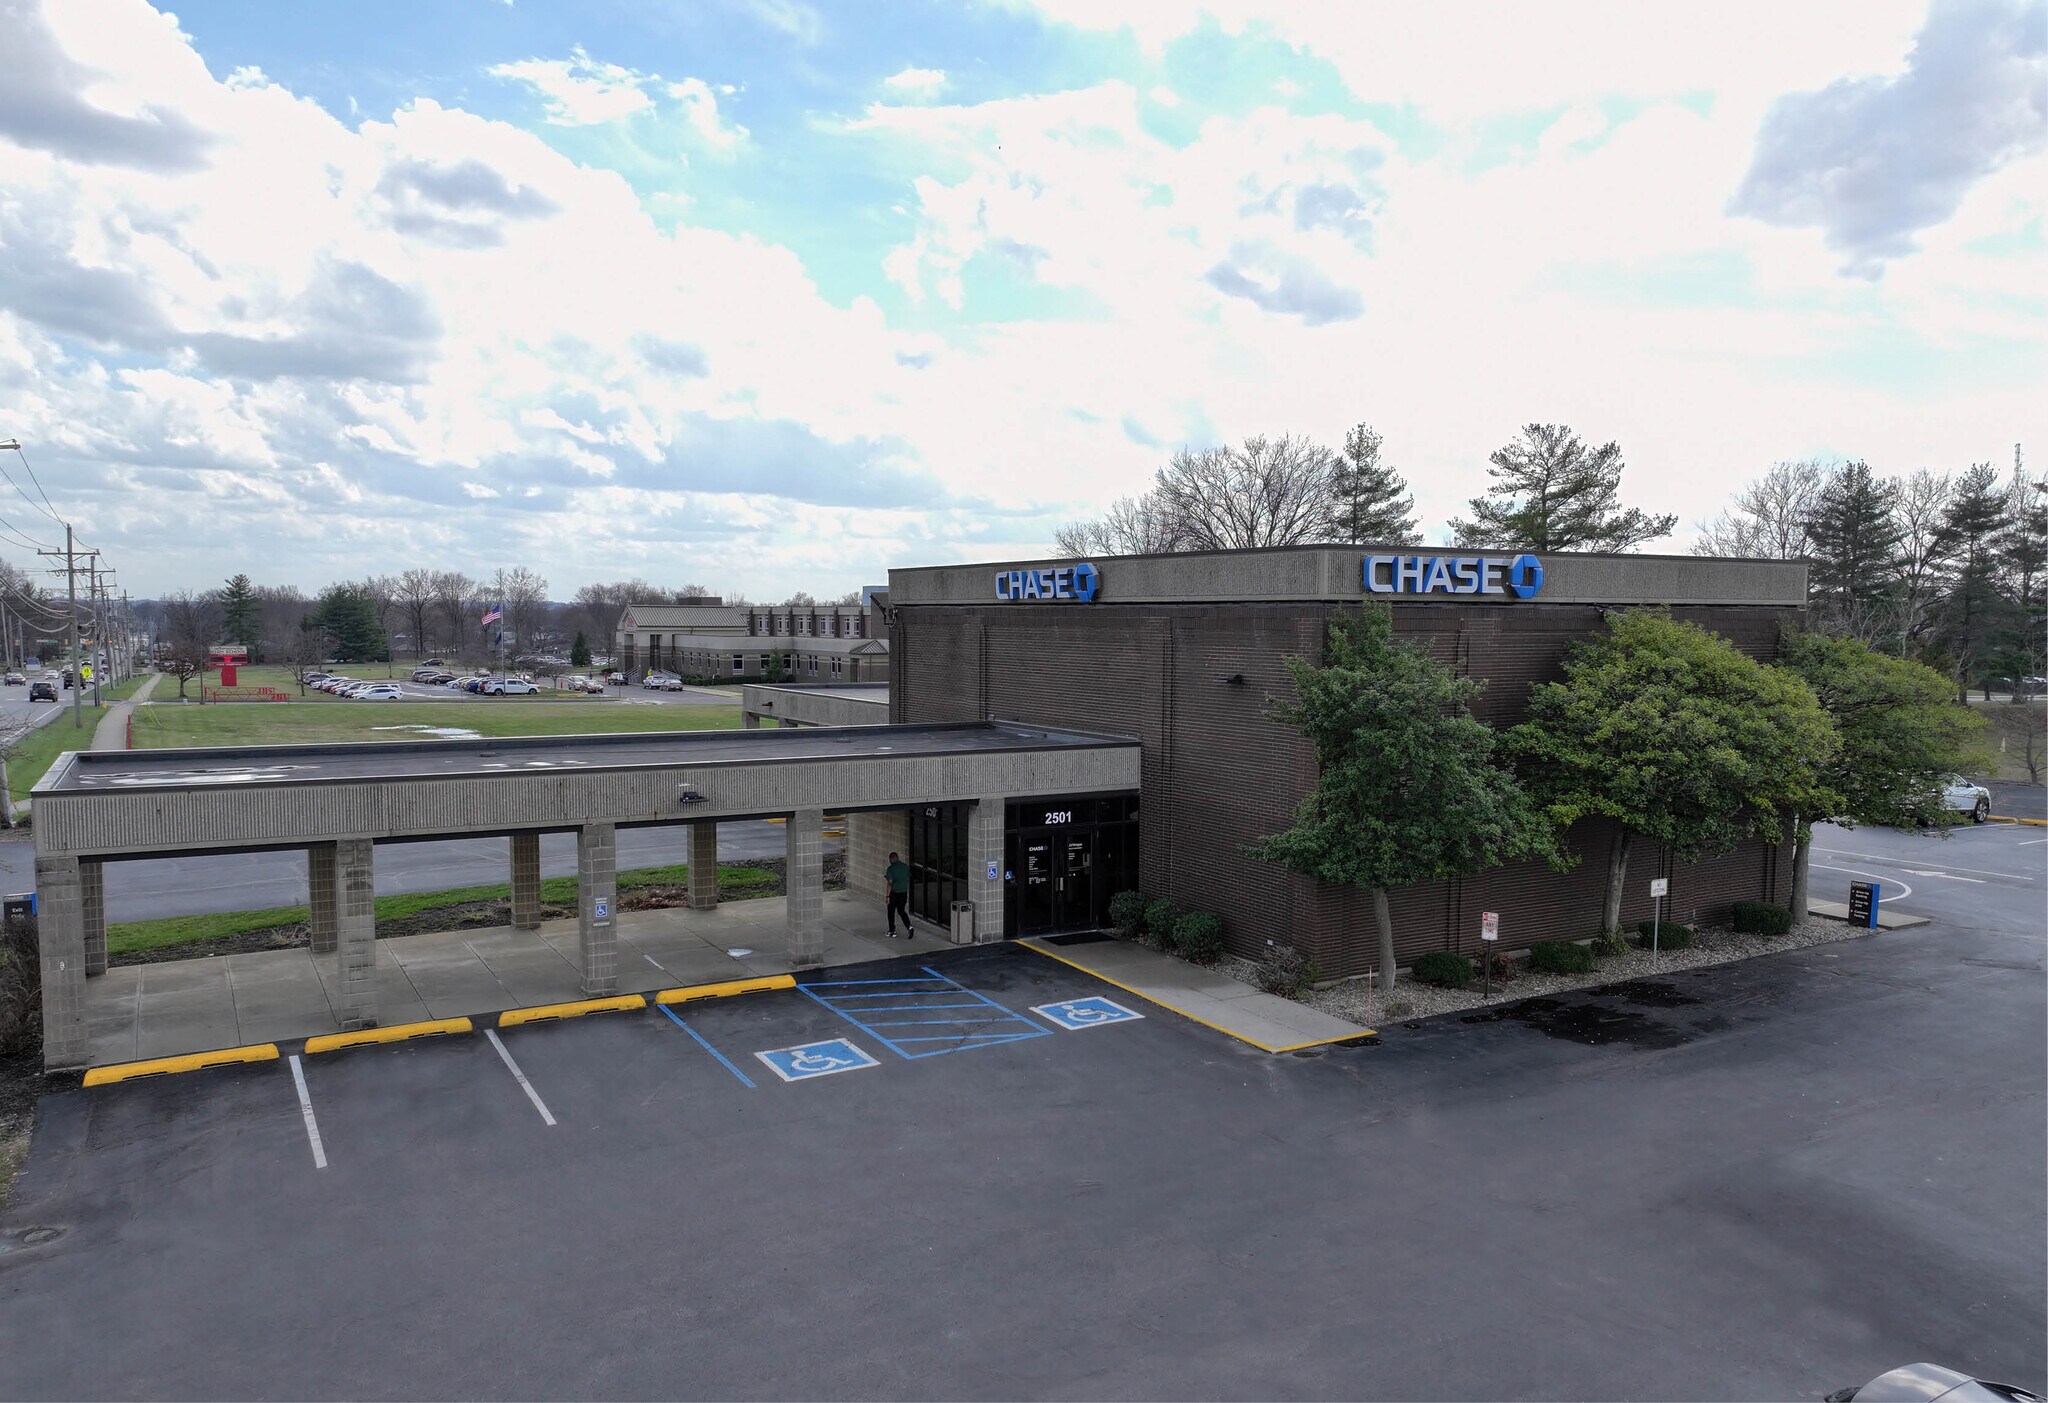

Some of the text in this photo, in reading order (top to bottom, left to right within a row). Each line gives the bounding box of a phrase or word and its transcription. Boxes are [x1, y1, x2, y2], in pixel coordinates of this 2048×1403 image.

[995, 567, 1074, 600] CHASE
[1364, 555, 1505, 594] CHASE
[1045, 811, 1072, 824] 2501
